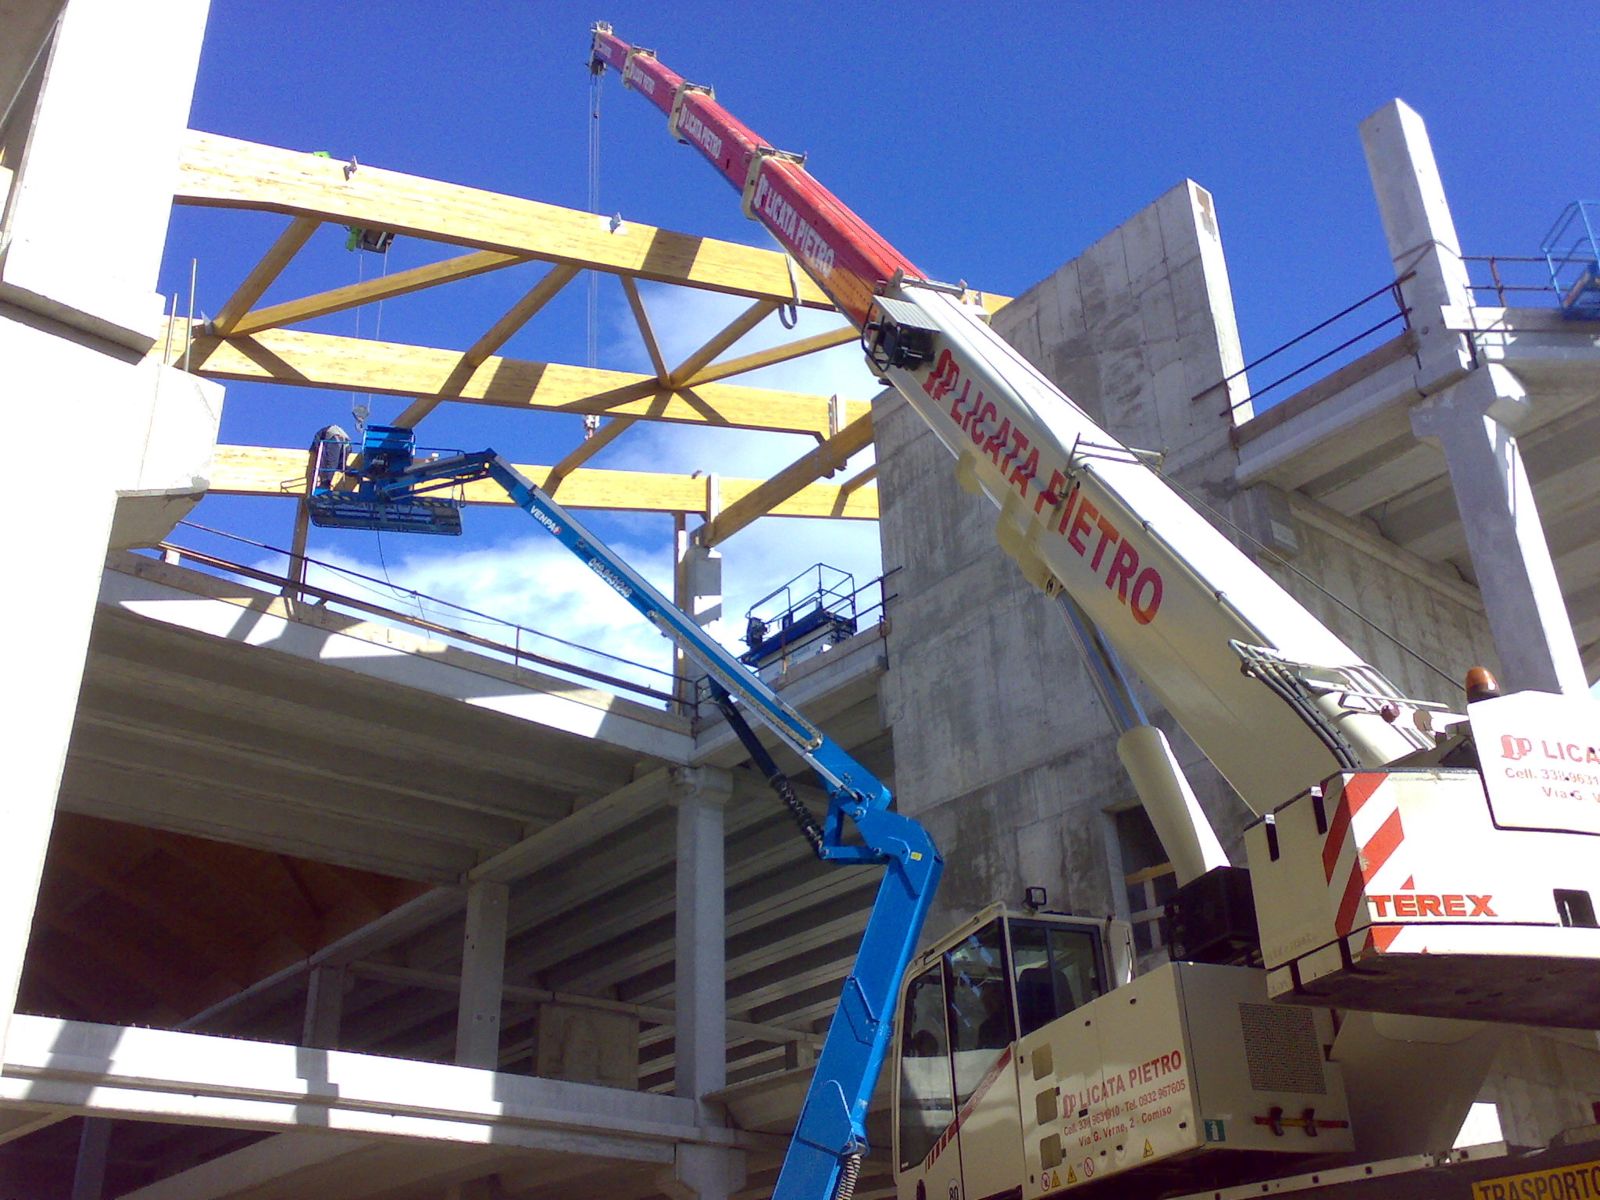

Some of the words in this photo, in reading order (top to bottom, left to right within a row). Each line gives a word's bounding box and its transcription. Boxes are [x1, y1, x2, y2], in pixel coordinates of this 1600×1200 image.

[765, 188, 797, 240] LICATA
[795, 219, 835, 278] PIETRO
[950, 378, 1041, 500] LICATA
[1033, 468, 1164, 626] PIETRO
[1541, 740, 1600, 764] LICA
[1541, 786, 1567, 799] Via
[1367, 894, 1498, 917] TEREX
[1079, 1074, 1126, 1110] LICATA
[1129, 1049, 1182, 1089] PIETRO
[1138, 1090, 1158, 1106] 0932
[1078, 1133, 1091, 1147] Via
[1093, 1131, 1102, 1142] G.
[1129, 1117, 1136, 1129] 2
[1141, 1105, 1172, 1124] Comiso
[948, 1186, 960, 1200] 80
